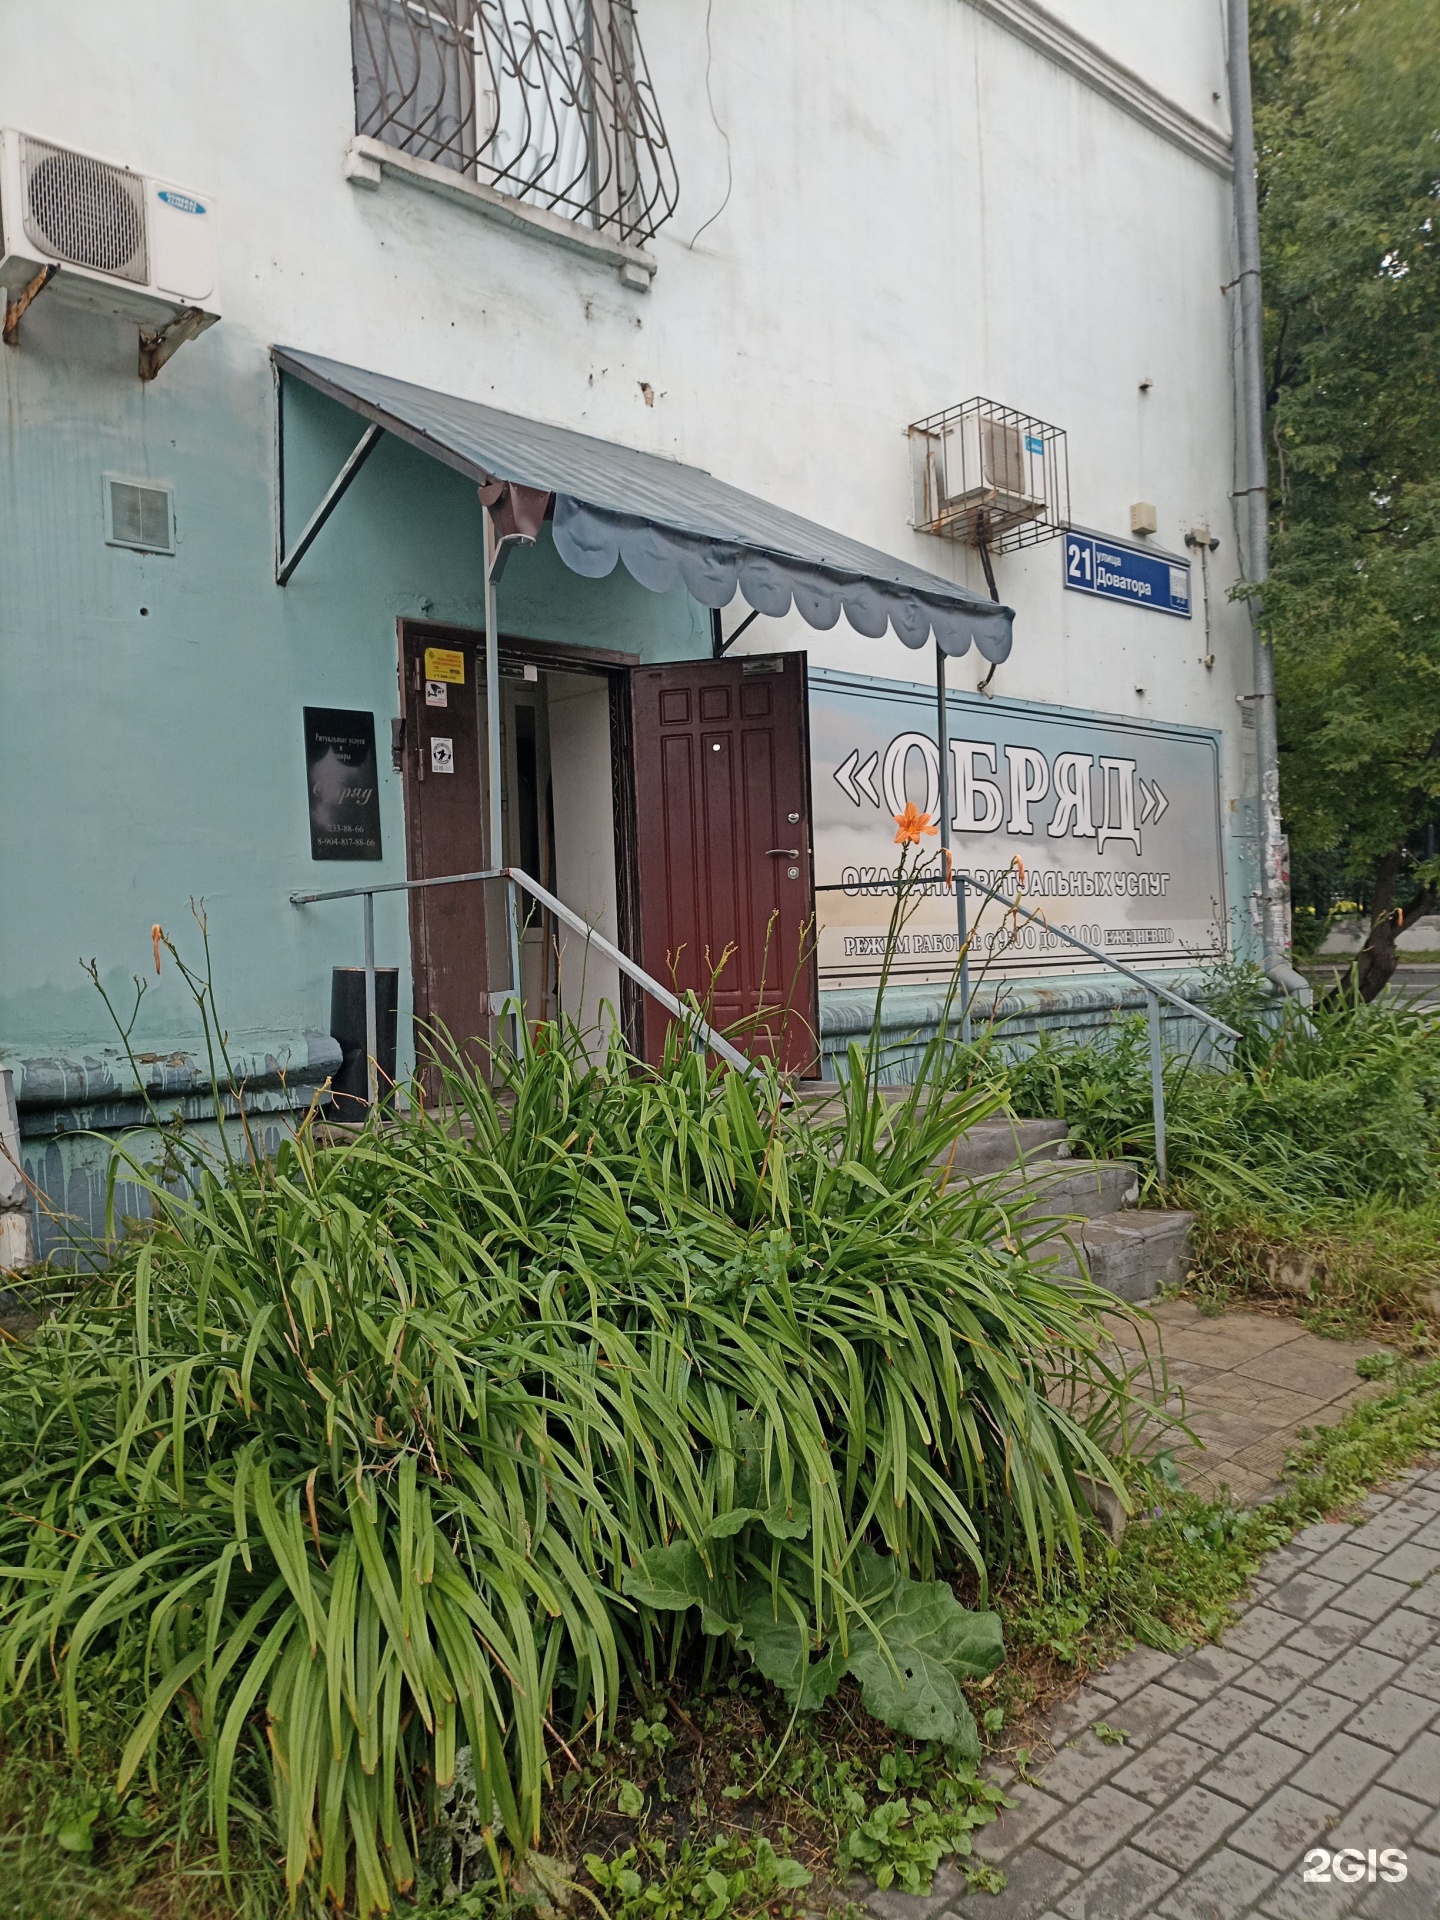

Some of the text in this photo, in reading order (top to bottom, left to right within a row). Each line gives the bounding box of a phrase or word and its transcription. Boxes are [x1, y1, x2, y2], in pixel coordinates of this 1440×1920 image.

[1068, 543, 1092, 581] 21
[1096, 550, 1122, 567] улица
[1096, 566, 1152, 598] Доватора
[348, 737, 366, 747] услуги
[327, 824, 364, 833] 233-88-66
[317, 837, 375, 847] 8-904-817-88-66
[842, 866, 1170, 897] ОКАЗАНИЕ РИТУАЛЬНЫХ УСЛУГ
[844, 935, 910, 956] РЕЖИМ
[997, 926, 1036, 951] 9:00
[1104, 928, 1174, 947] ЕЖЕДНЕВНО
